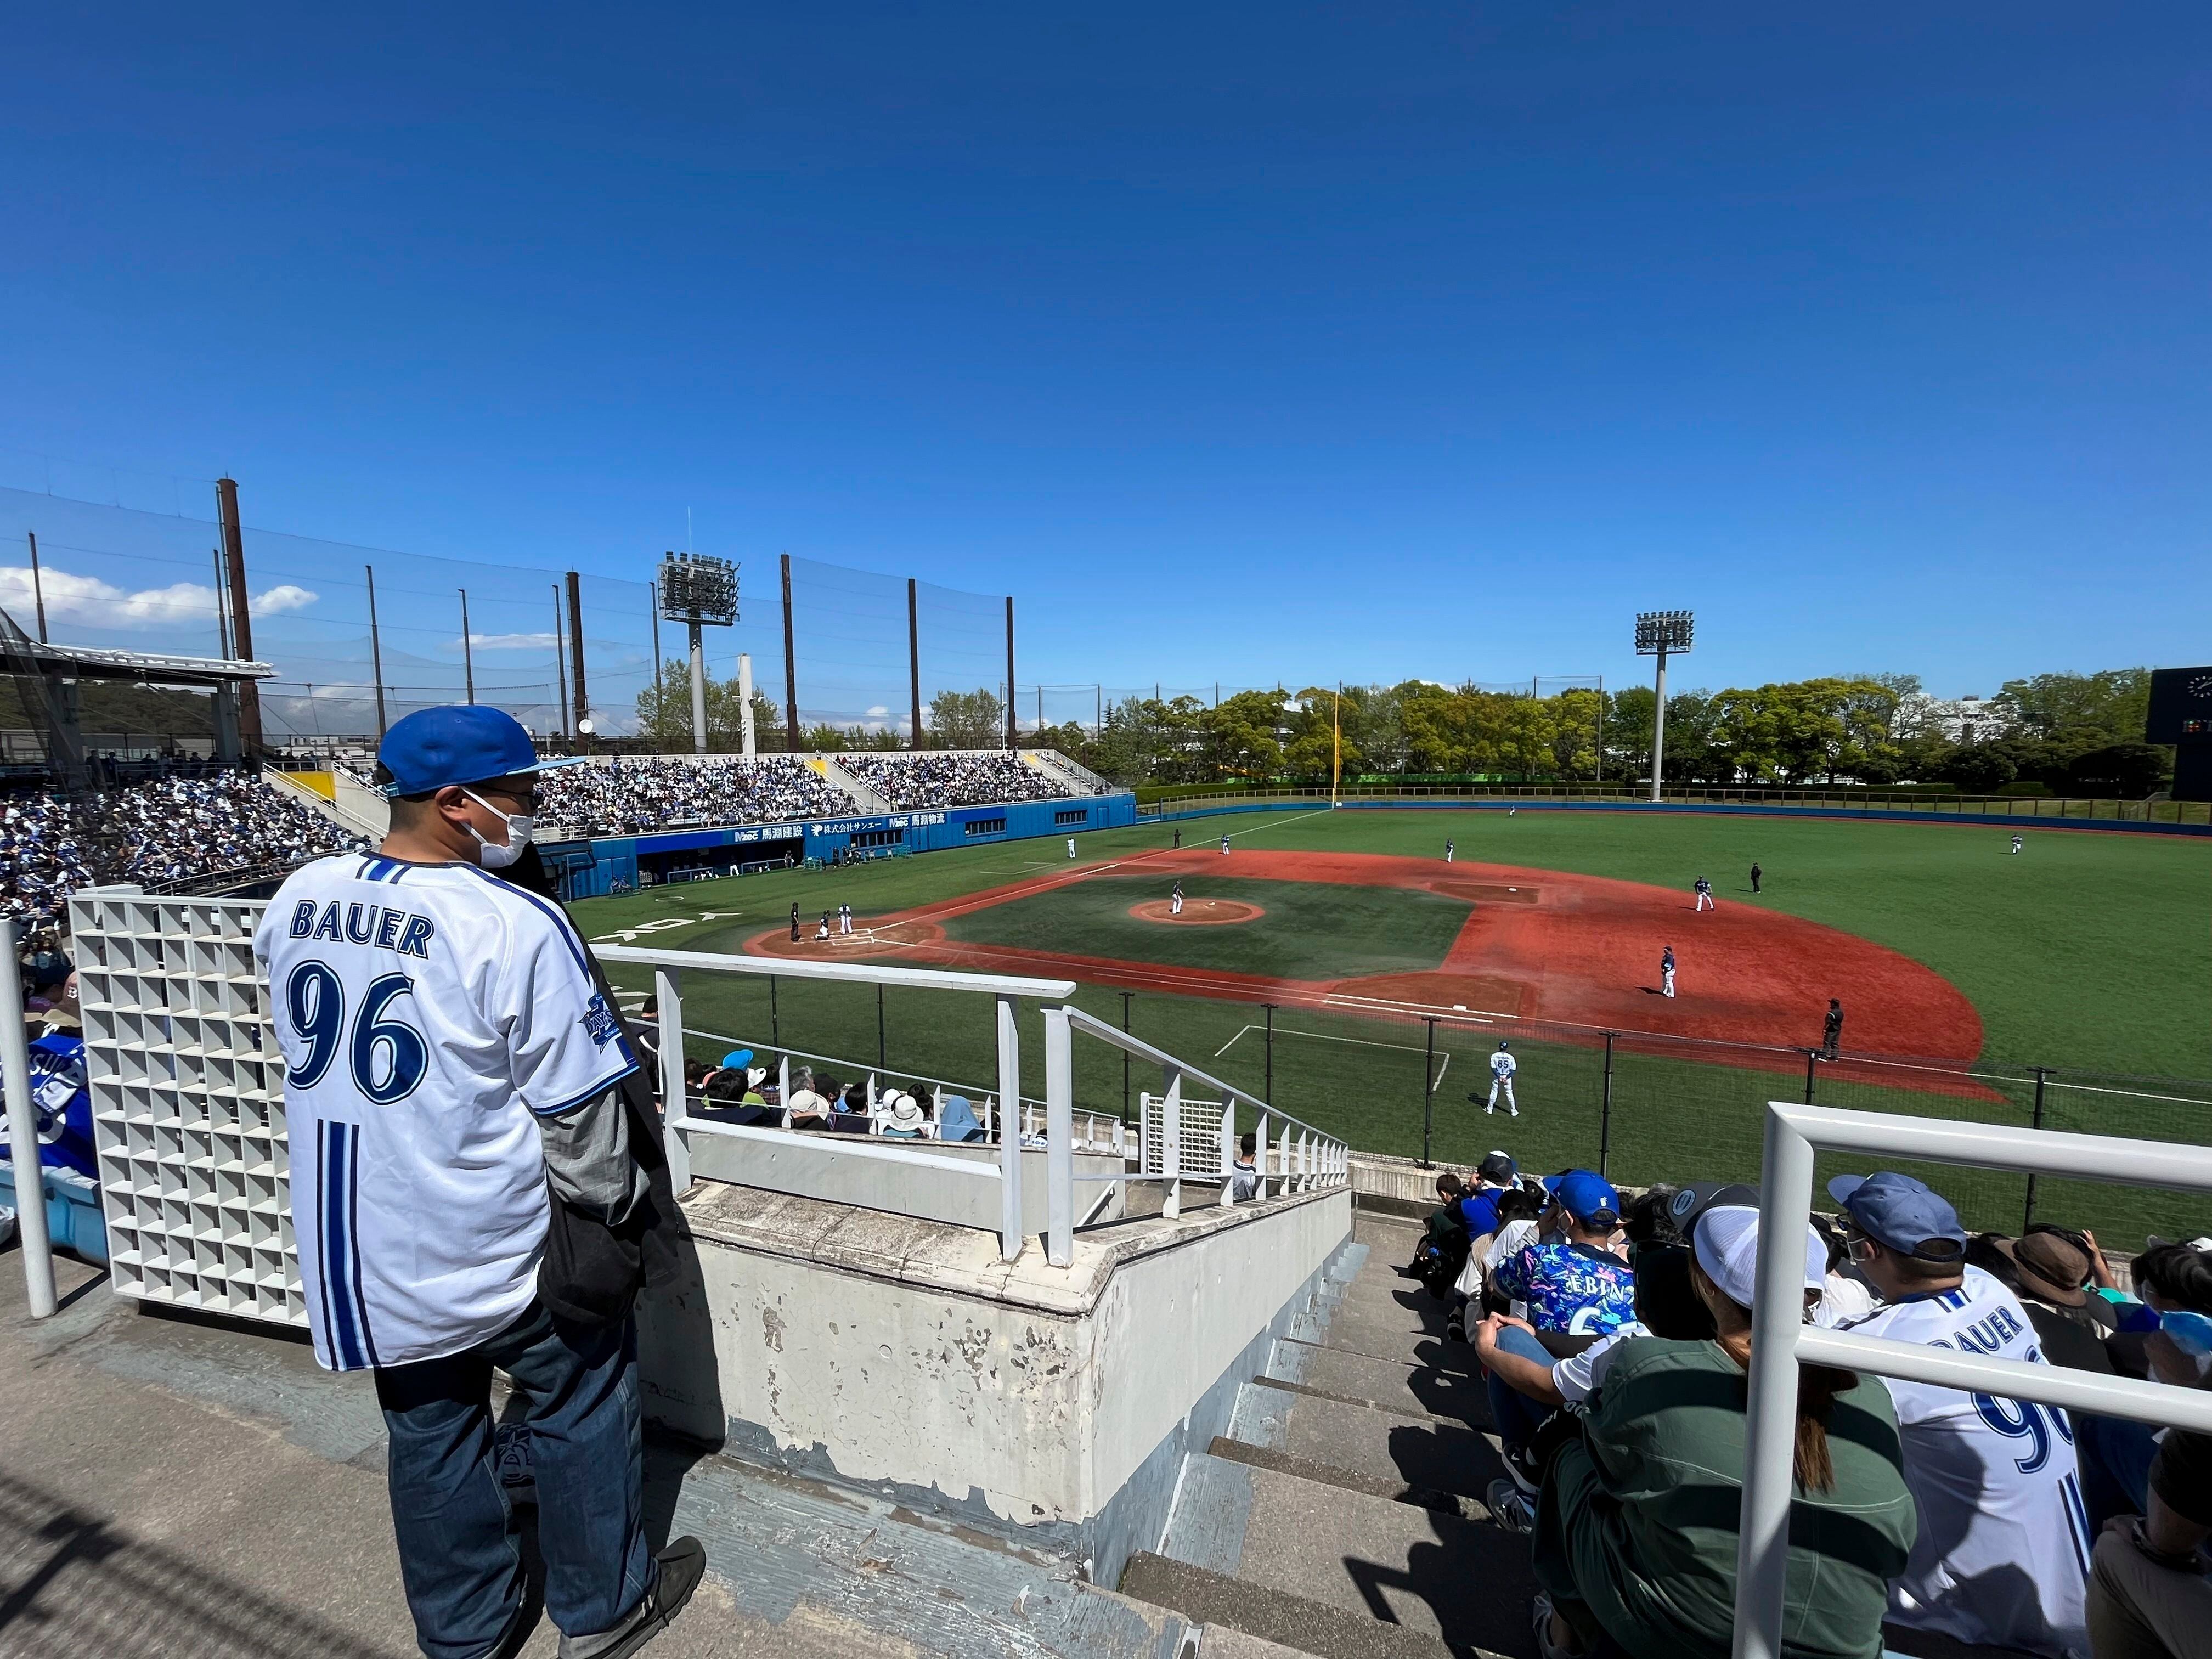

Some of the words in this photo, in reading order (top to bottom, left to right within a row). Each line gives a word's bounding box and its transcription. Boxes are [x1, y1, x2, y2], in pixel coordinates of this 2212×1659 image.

[823, 822, 882, 834] 株式会社サンエー
[889, 816, 909, 828] Mzec
[735, 830, 759, 842] Mzec
[290, 900, 434, 959] BAUER
[286, 959, 429, 1105] 96
[1498, 1059, 1509, 1069] 85
